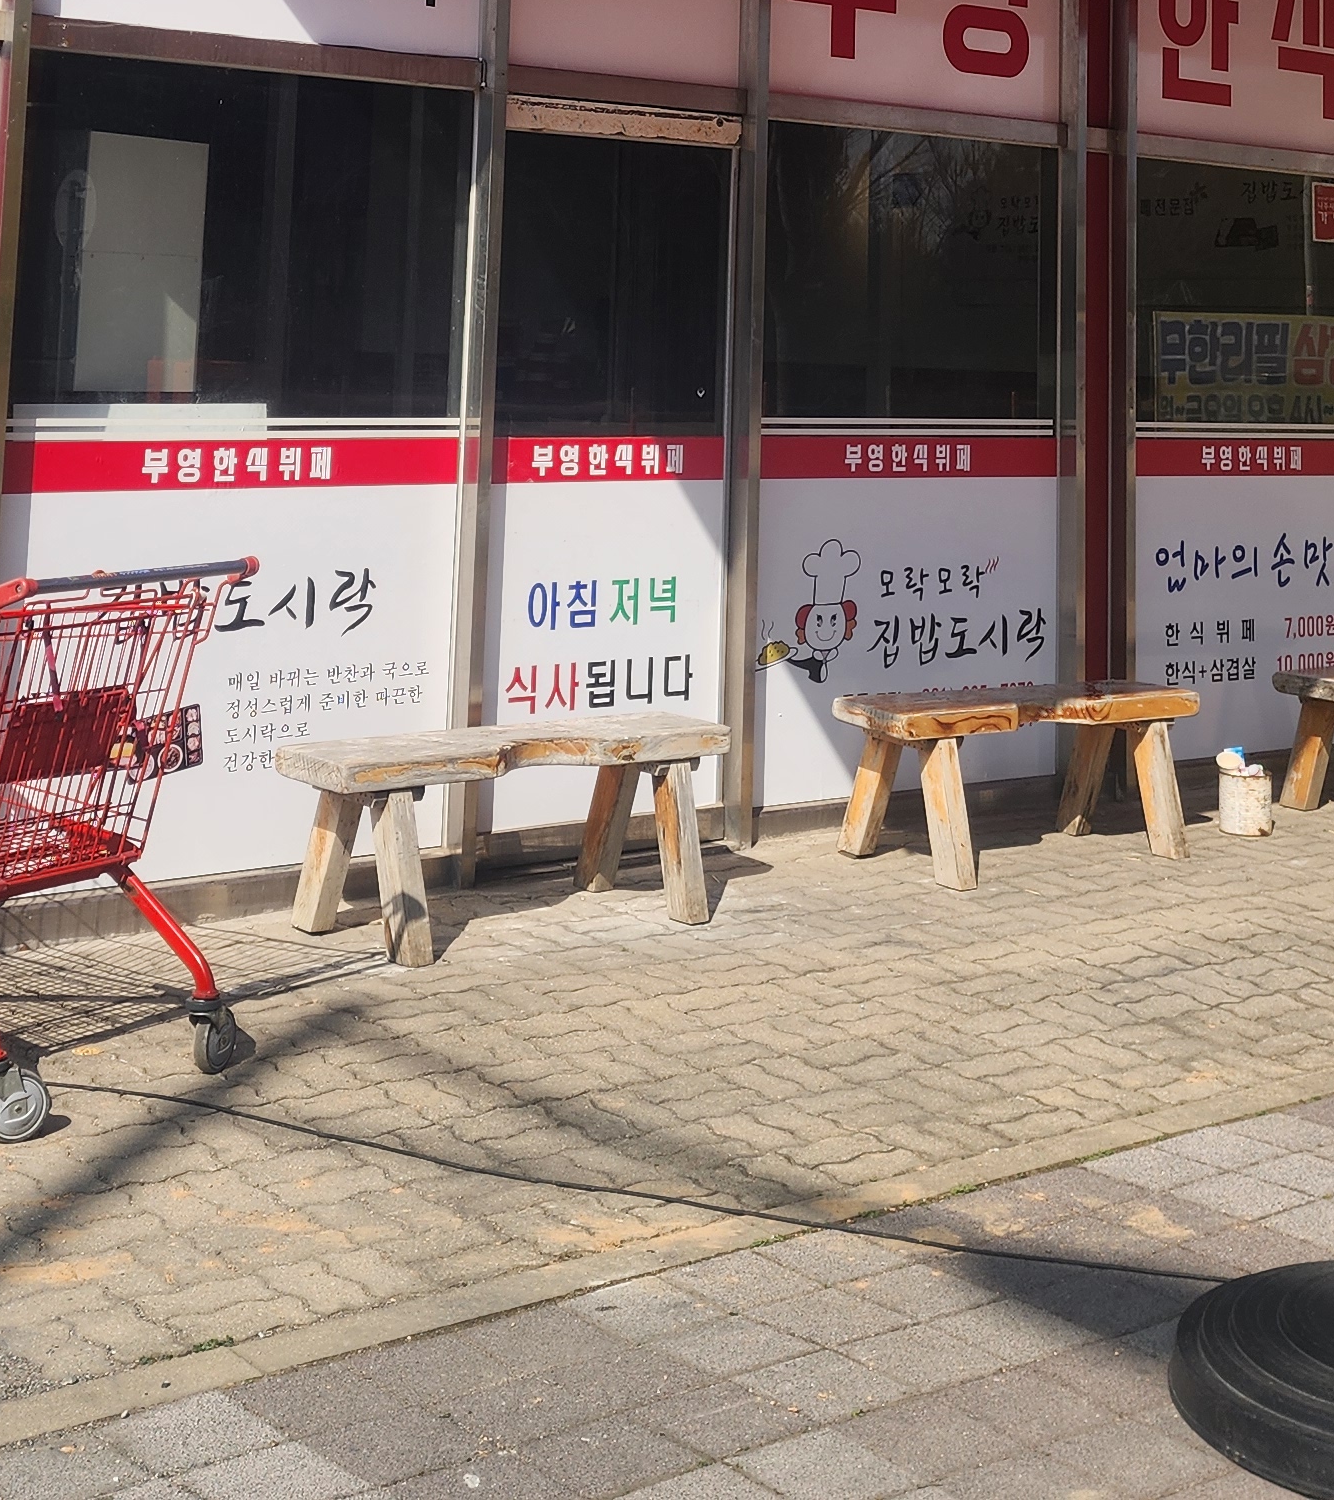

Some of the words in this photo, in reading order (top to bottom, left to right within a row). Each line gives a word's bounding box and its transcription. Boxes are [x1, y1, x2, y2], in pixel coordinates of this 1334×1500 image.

[1159, 319, 1290, 386] 무한리필
[527, 579, 599, 631] 아침
[609, 575, 678, 626] 저녁
[867, 607, 1047, 670] 집밥도시락
[228, 670, 261, 692] 매일
[269, 667, 320, 690] 바뀌는
[327, 663, 376, 685] 반찬과
[382, 661, 430, 681] 국으로
[505, 653, 694, 716] 식사됩니다
[1165, 656, 1256, 687] 한식+삼겹살
[225, 693, 312, 720] 정성스럽게
[319, 688, 369, 712] 준비한
[375, 684, 423, 707] 따끈한
[223, 721, 311, 745] 도시락으로
[223, 749, 275, 773] 건강한
